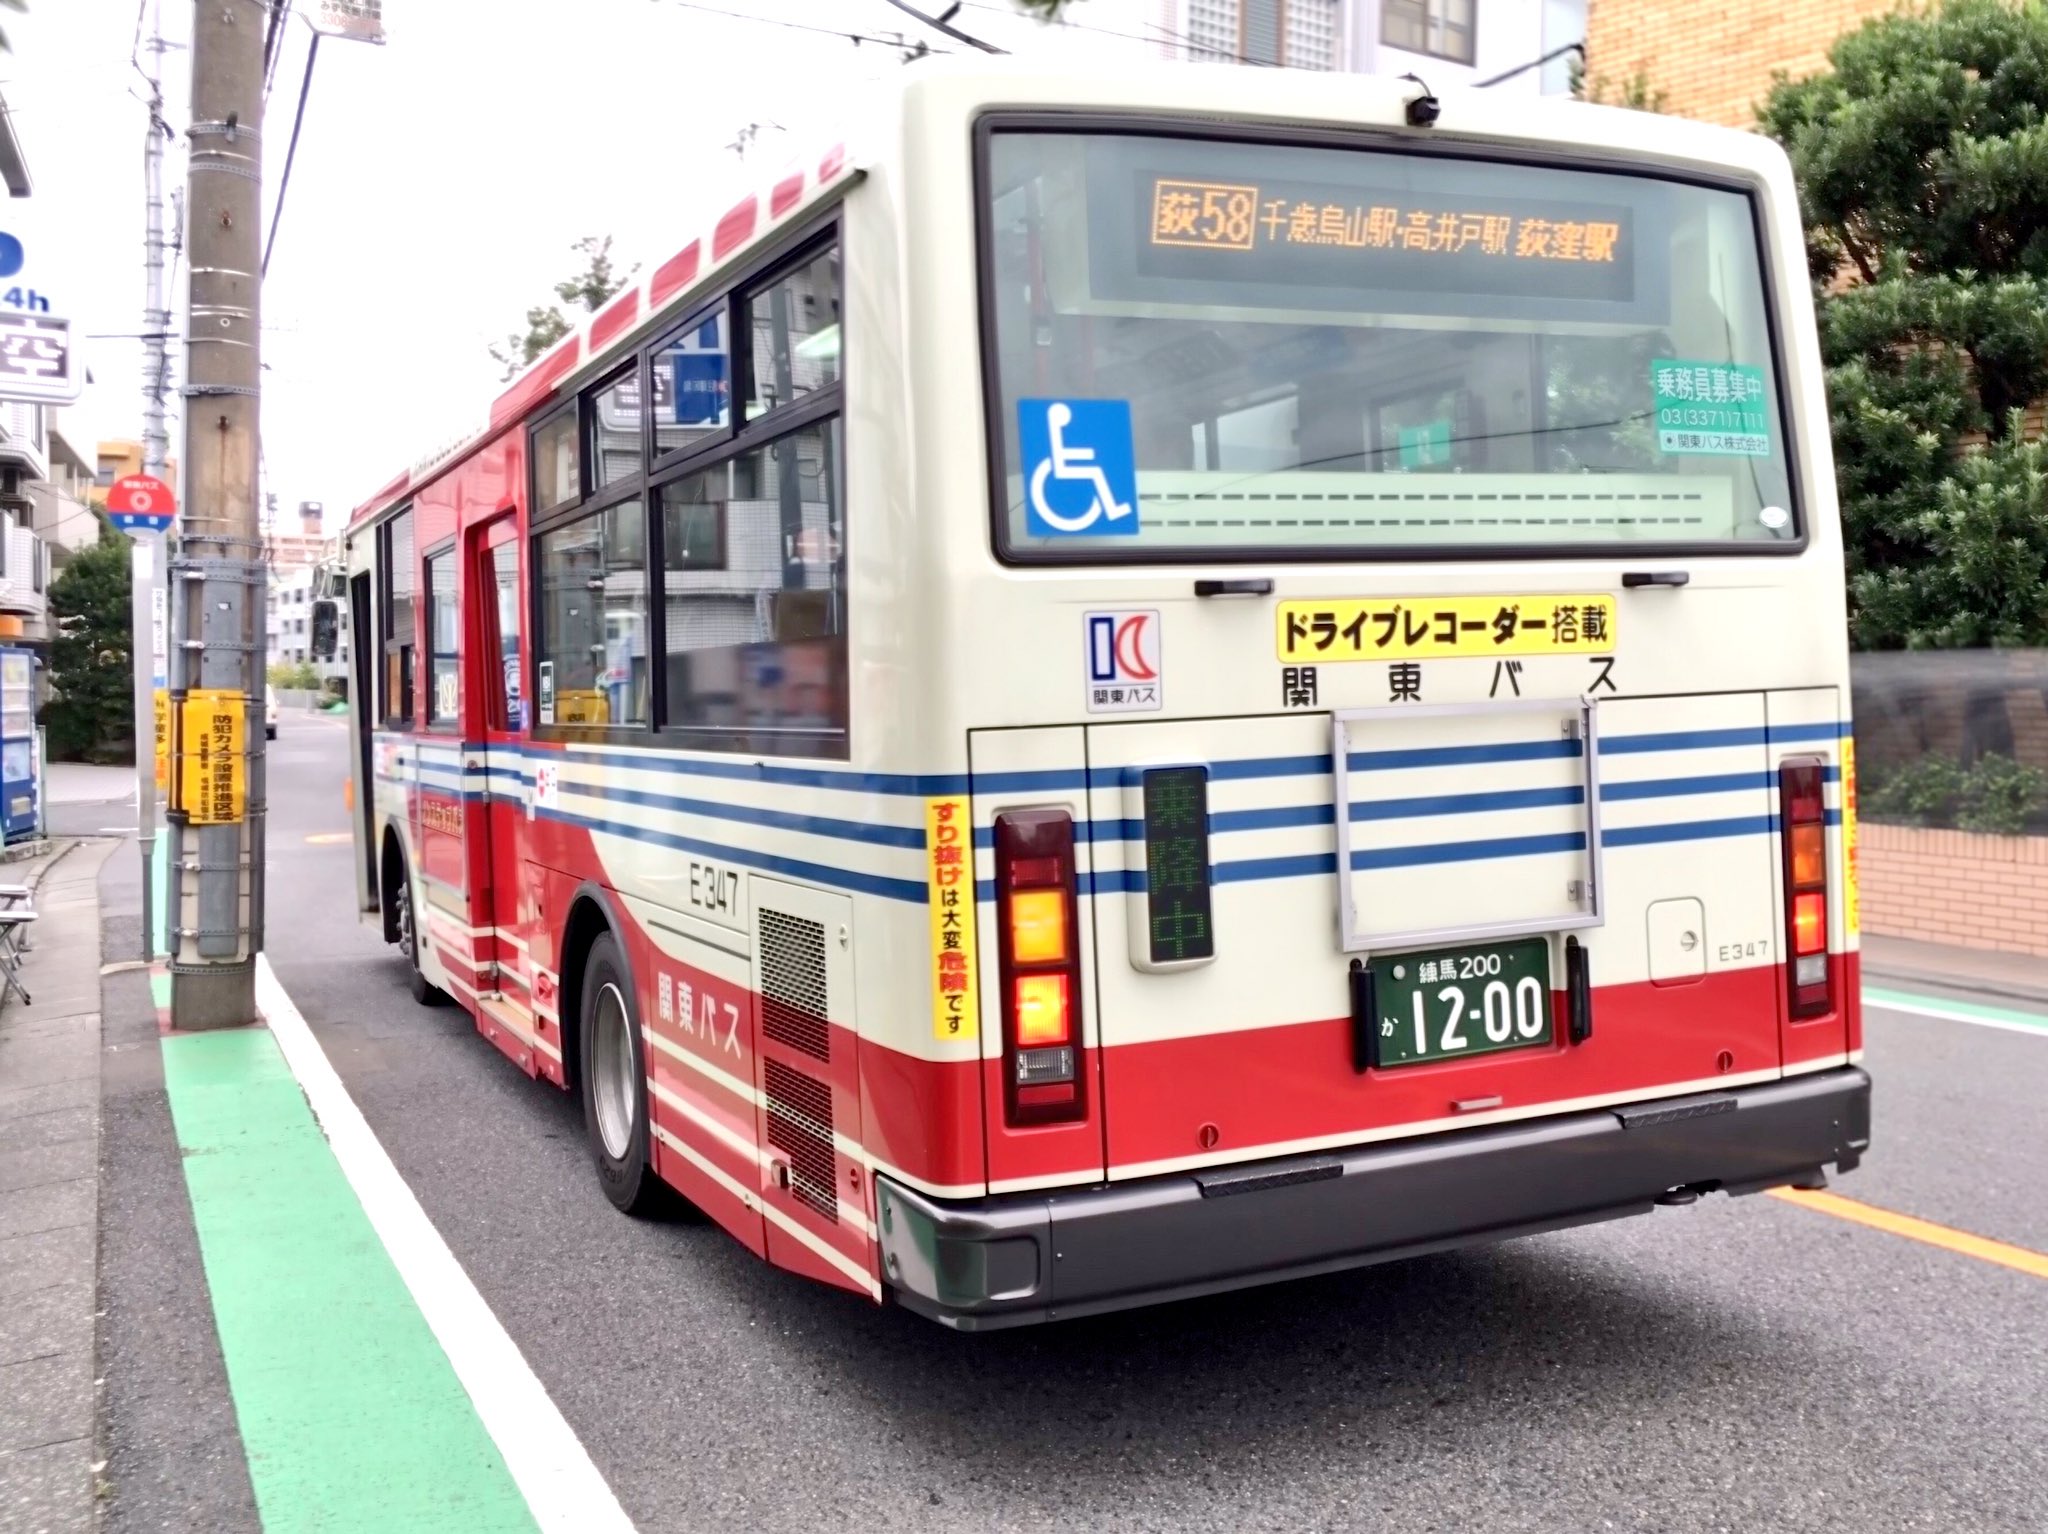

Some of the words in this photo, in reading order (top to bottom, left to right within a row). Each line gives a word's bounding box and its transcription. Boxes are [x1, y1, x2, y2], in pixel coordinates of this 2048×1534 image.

[1159, 191, 1254, 242] 荻58
[1515, 218, 1619, 262] 荻窪駅
[1657, 367, 1762, 403] 乗務員募集中
[1661, 408, 1764, 428] 03(3371)7111
[1677, 433, 1768, 452] 関東バス株式会社
[1285, 604, 1608, 653] ドライブレコーダー搭載
[1094, 688, 1156, 705] 関東バス
[1282, 656, 1617, 707] 関東バス
[690, 862, 738, 917] E347
[932, 802, 968, 1033] すり抜けは大変危険です
[1718, 940, 1769, 961] E347
[658, 971, 741, 1060] 関東バス
[1381, 1016, 1399, 1037] か
[1412, 976, 1543, 1054] 12-00
